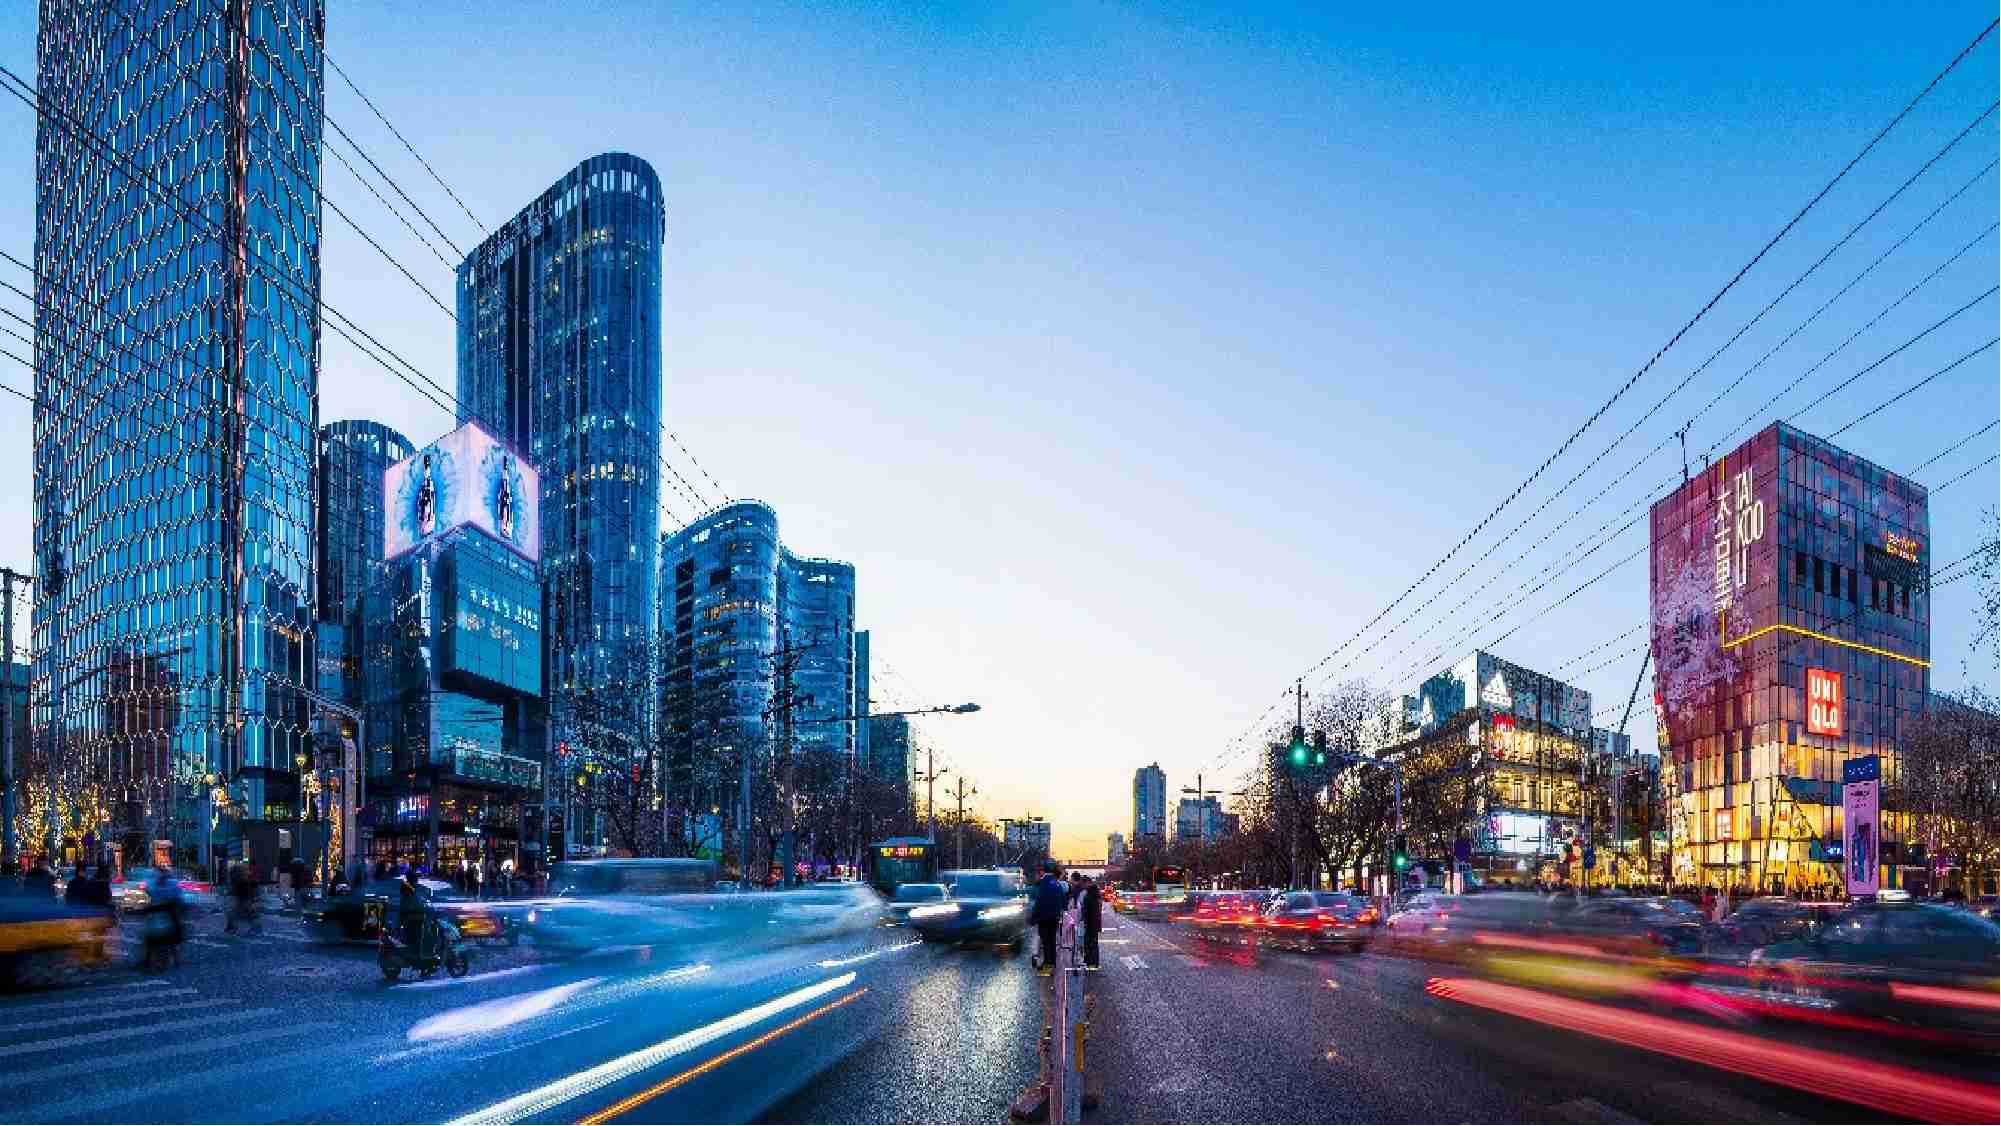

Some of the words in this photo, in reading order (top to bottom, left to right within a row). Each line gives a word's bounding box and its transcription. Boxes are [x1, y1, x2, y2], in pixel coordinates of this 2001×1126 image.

[1736, 466, 1752, 508] TAI
[1737, 500, 1763, 546] KOO
[1812, 676, 1837, 702] UNI
[1812, 703, 1837, 731] QLO
